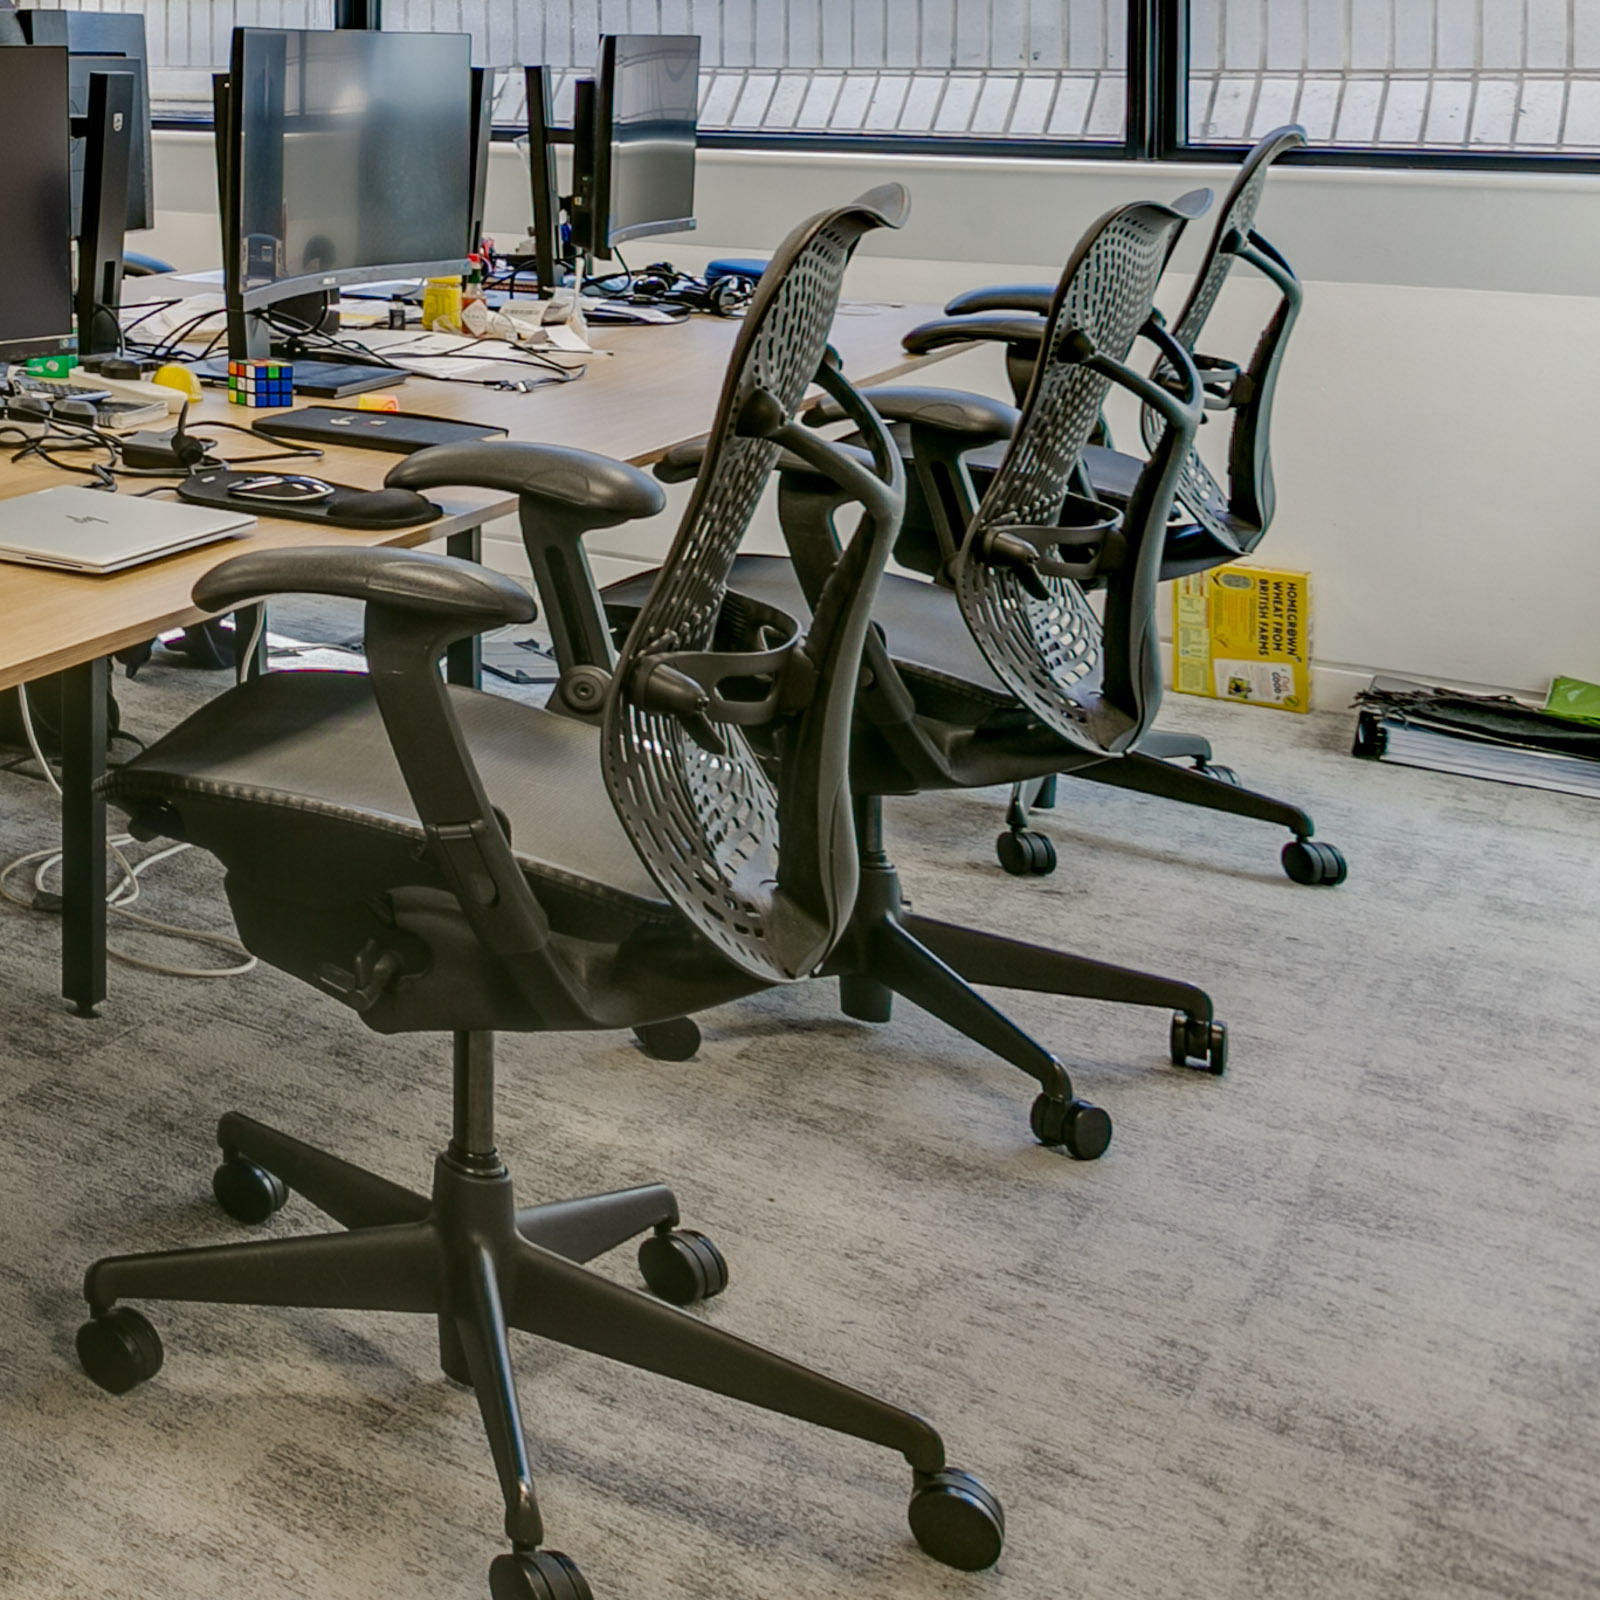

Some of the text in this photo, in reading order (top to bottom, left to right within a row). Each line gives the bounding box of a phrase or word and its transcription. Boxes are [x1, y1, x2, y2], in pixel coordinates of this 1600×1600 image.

[1259, 578, 1269, 656] BRITISH FARMS
[1272, 581, 1283, 652] WHEAT FROM
[1286, 582, 1299, 657] HOMEGROWN
